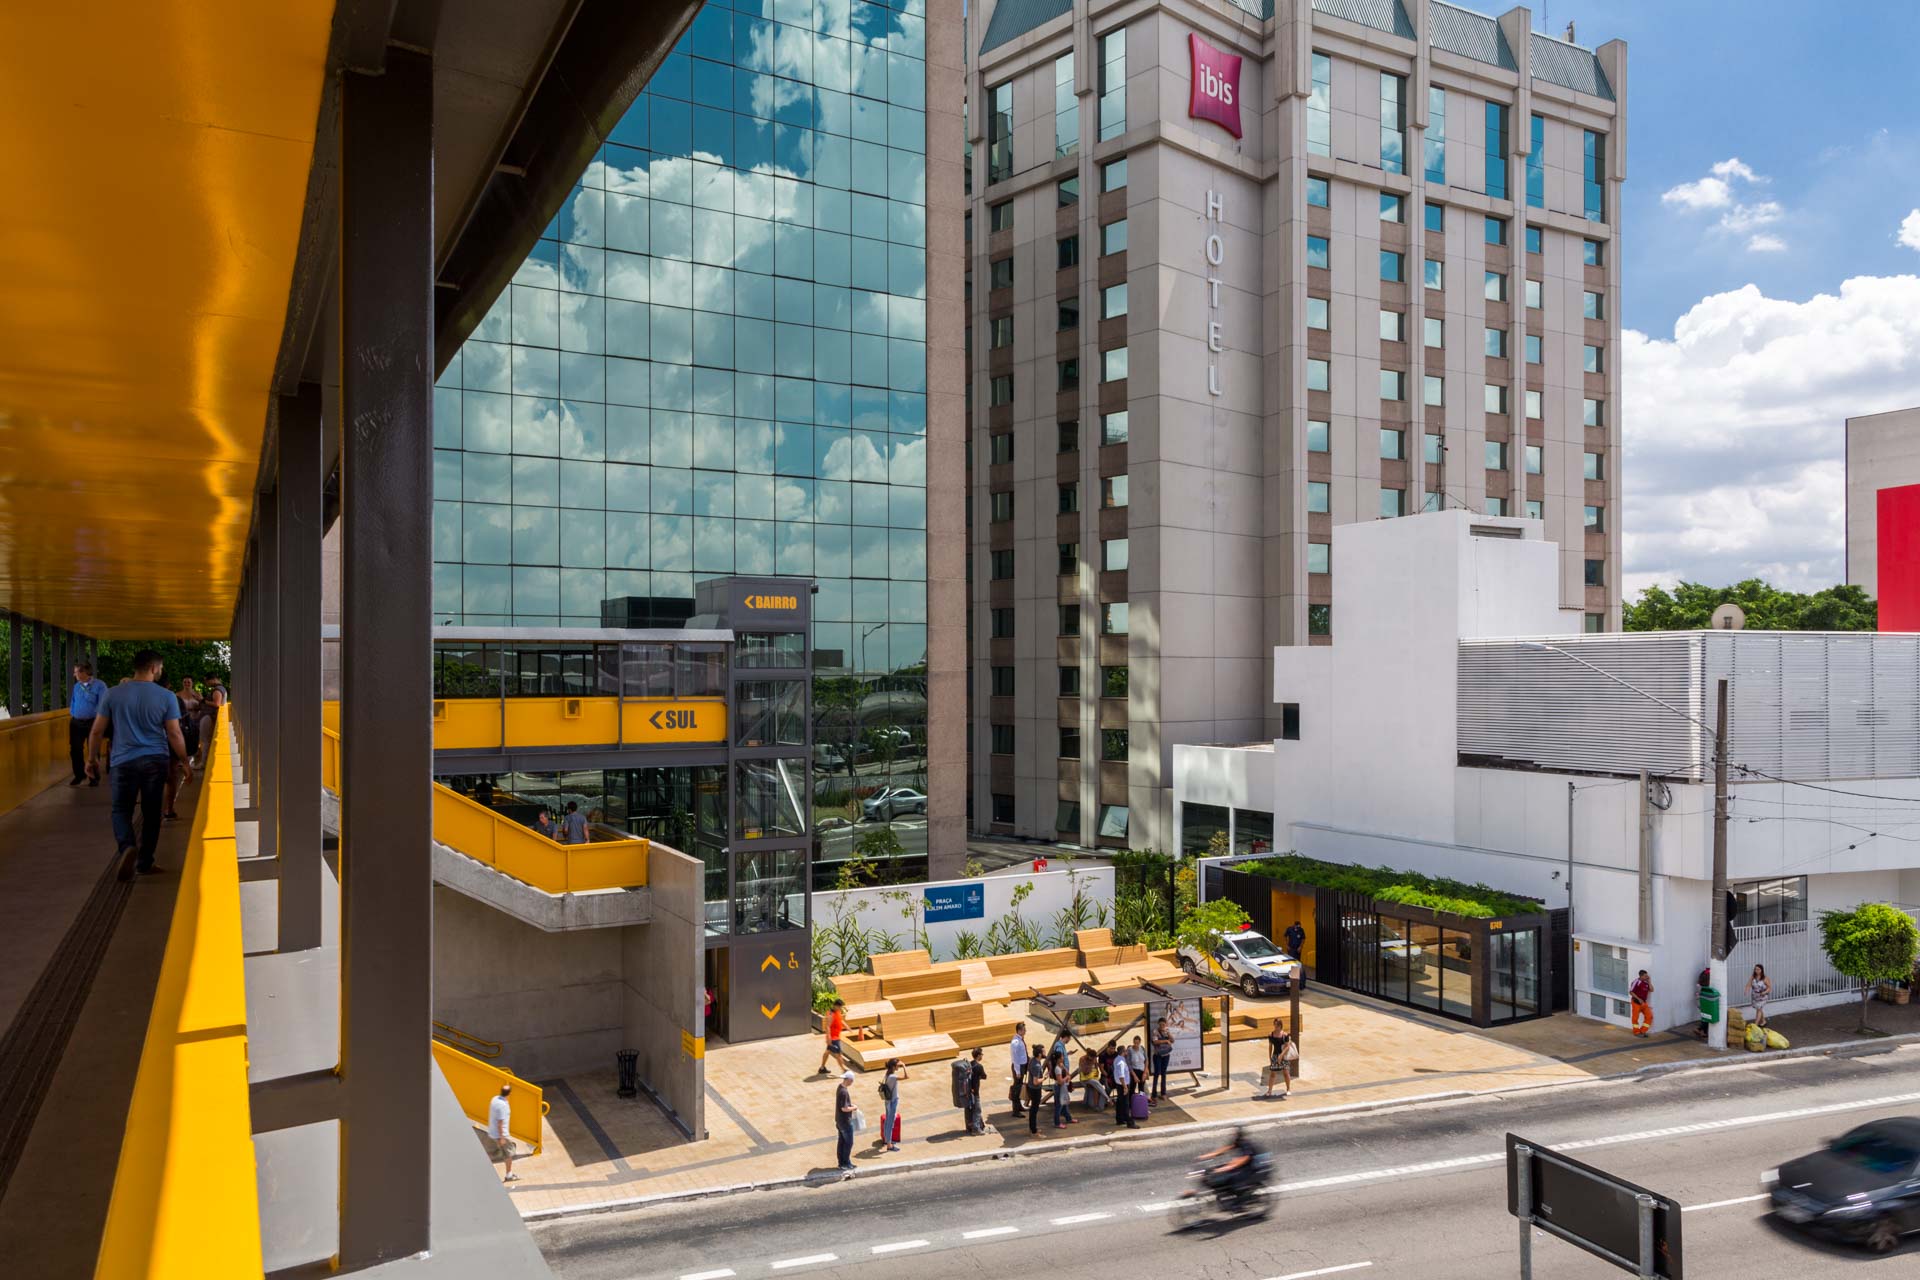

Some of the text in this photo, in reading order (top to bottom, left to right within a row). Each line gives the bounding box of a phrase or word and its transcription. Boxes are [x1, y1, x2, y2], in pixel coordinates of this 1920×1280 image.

[1200, 63, 1233, 105] ibis
[1206, 189, 1224, 396] HOTEL
[756, 596, 797, 609] BAIRRO
[666, 710, 698, 729] SUL
